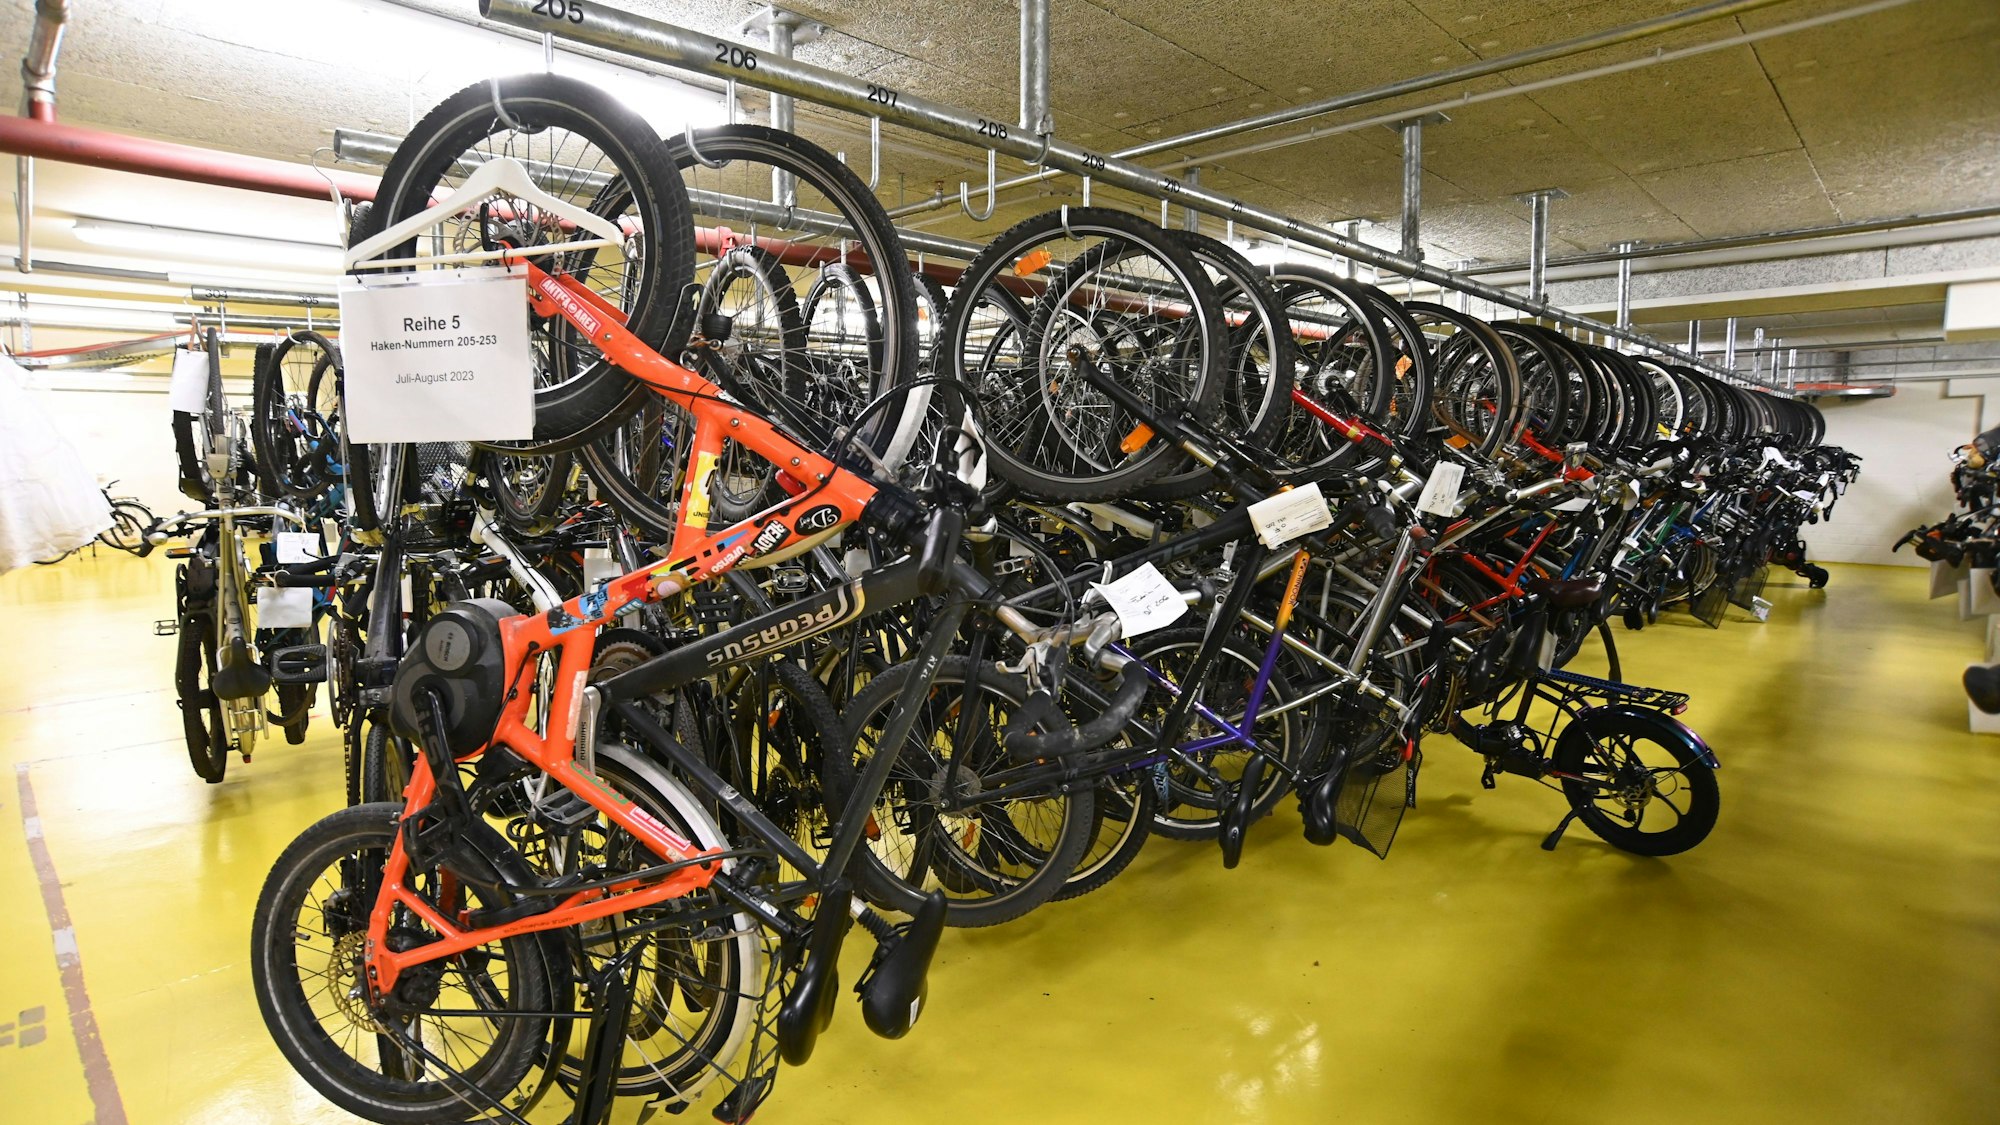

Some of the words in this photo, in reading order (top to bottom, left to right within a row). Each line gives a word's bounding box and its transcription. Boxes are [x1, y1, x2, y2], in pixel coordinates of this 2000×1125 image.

[531, 0, 584, 24] 205
[715, 43, 757, 70] 206
[867, 84, 898, 108] 207
[977, 118, 1008, 139] 208
[1081, 152, 1105, 171] 209
[1164, 177, 1181, 193] 210
[204, 289, 228, 299] 304
[299, 295, 319, 305] 305
[541, 279, 572, 309] ANTIFA
[573, 308, 598, 334] AREA
[403, 316, 447, 332] Reihe
[452, 315, 461, 330] 5
[371, 338, 454, 351] Haken-Nummern
[457, 335, 497, 347] 205-253
[396, 372, 447, 385] Juli-August
[450, 371, 475, 382] 2023
[754, 520, 787, 553] READY
[706, 603, 834, 667] PEGASUS
